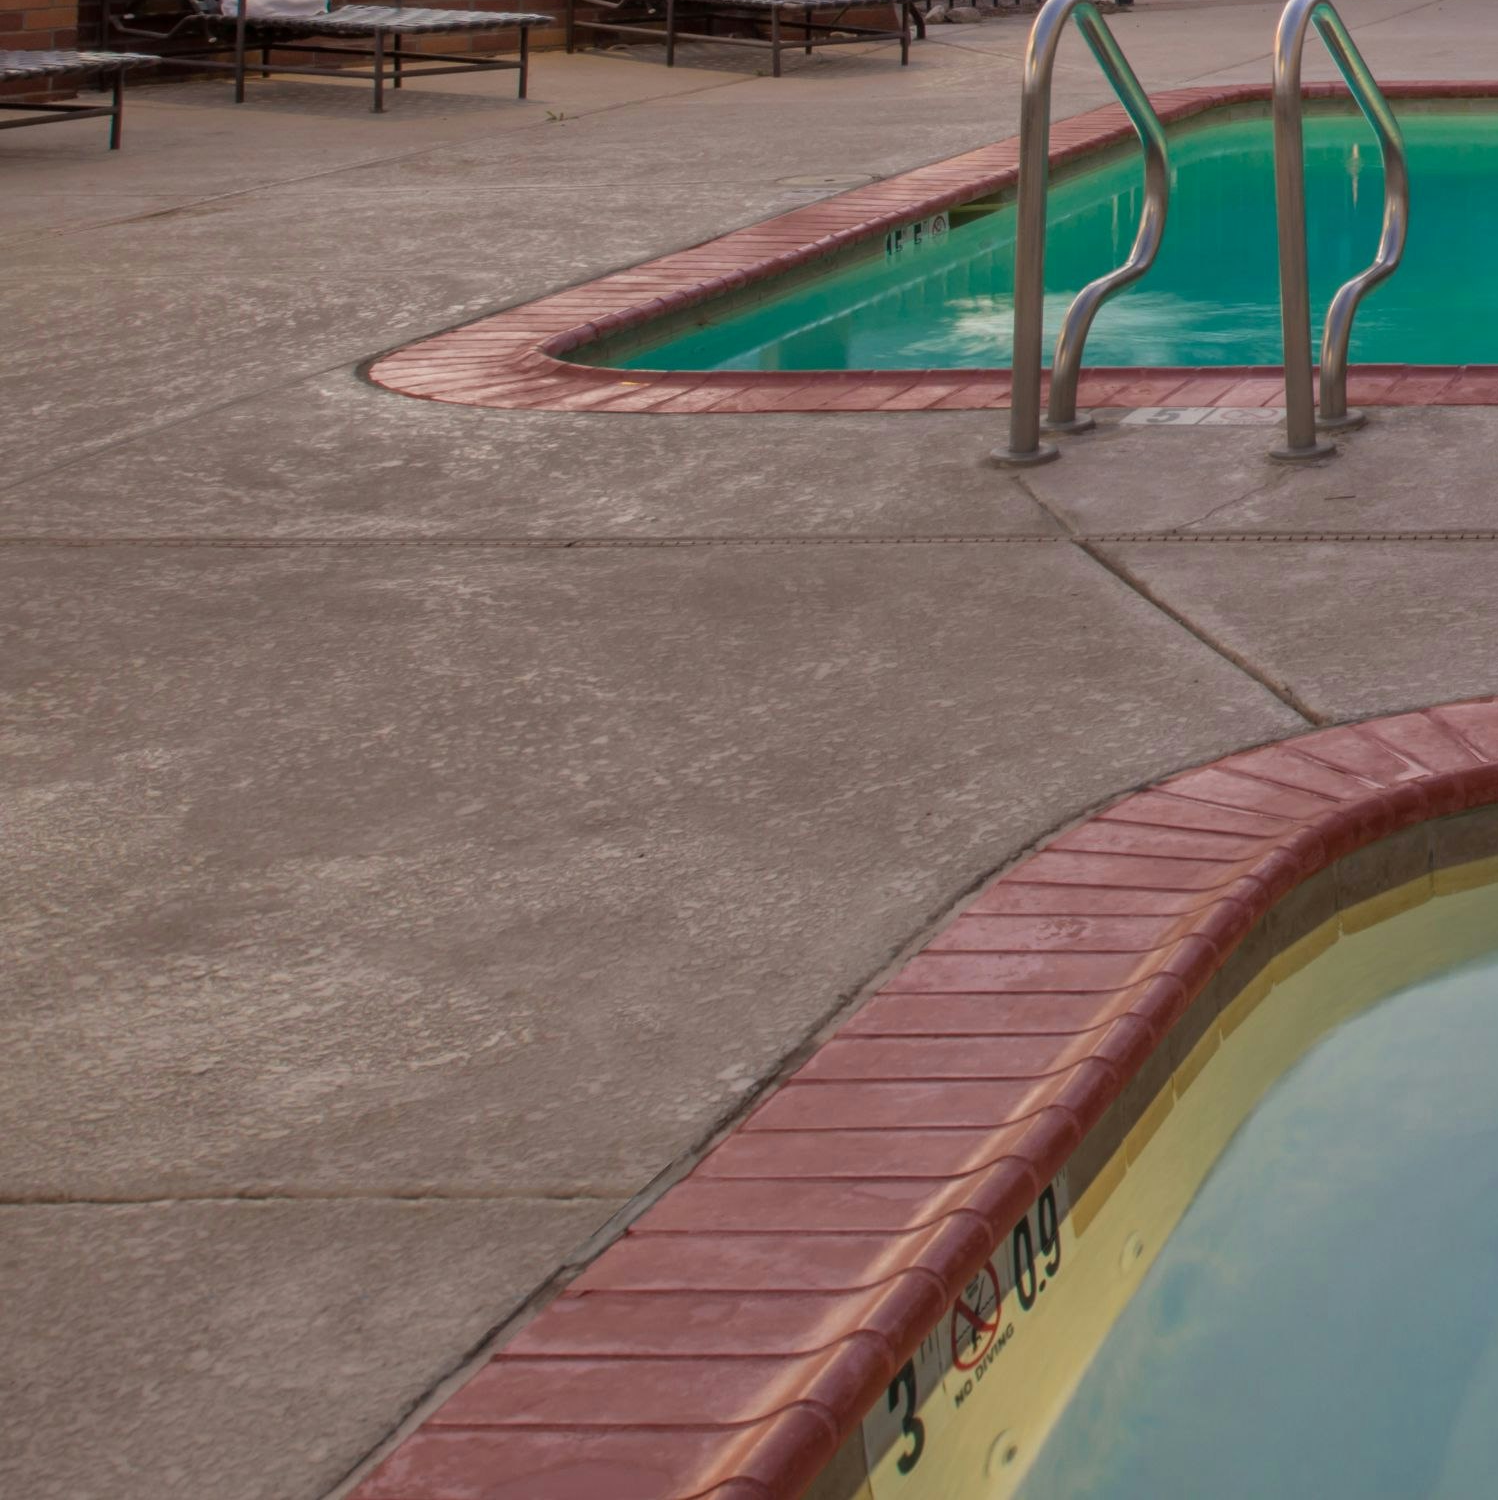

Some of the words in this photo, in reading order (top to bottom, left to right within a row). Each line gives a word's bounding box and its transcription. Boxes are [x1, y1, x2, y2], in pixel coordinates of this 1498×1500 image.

[1013, 1183, 1061, 1312] 0.9
[888, 1358, 925, 1476] 3
[954, 1378, 973, 1409] NO
[975, 1321, 1015, 1382] DIVING
